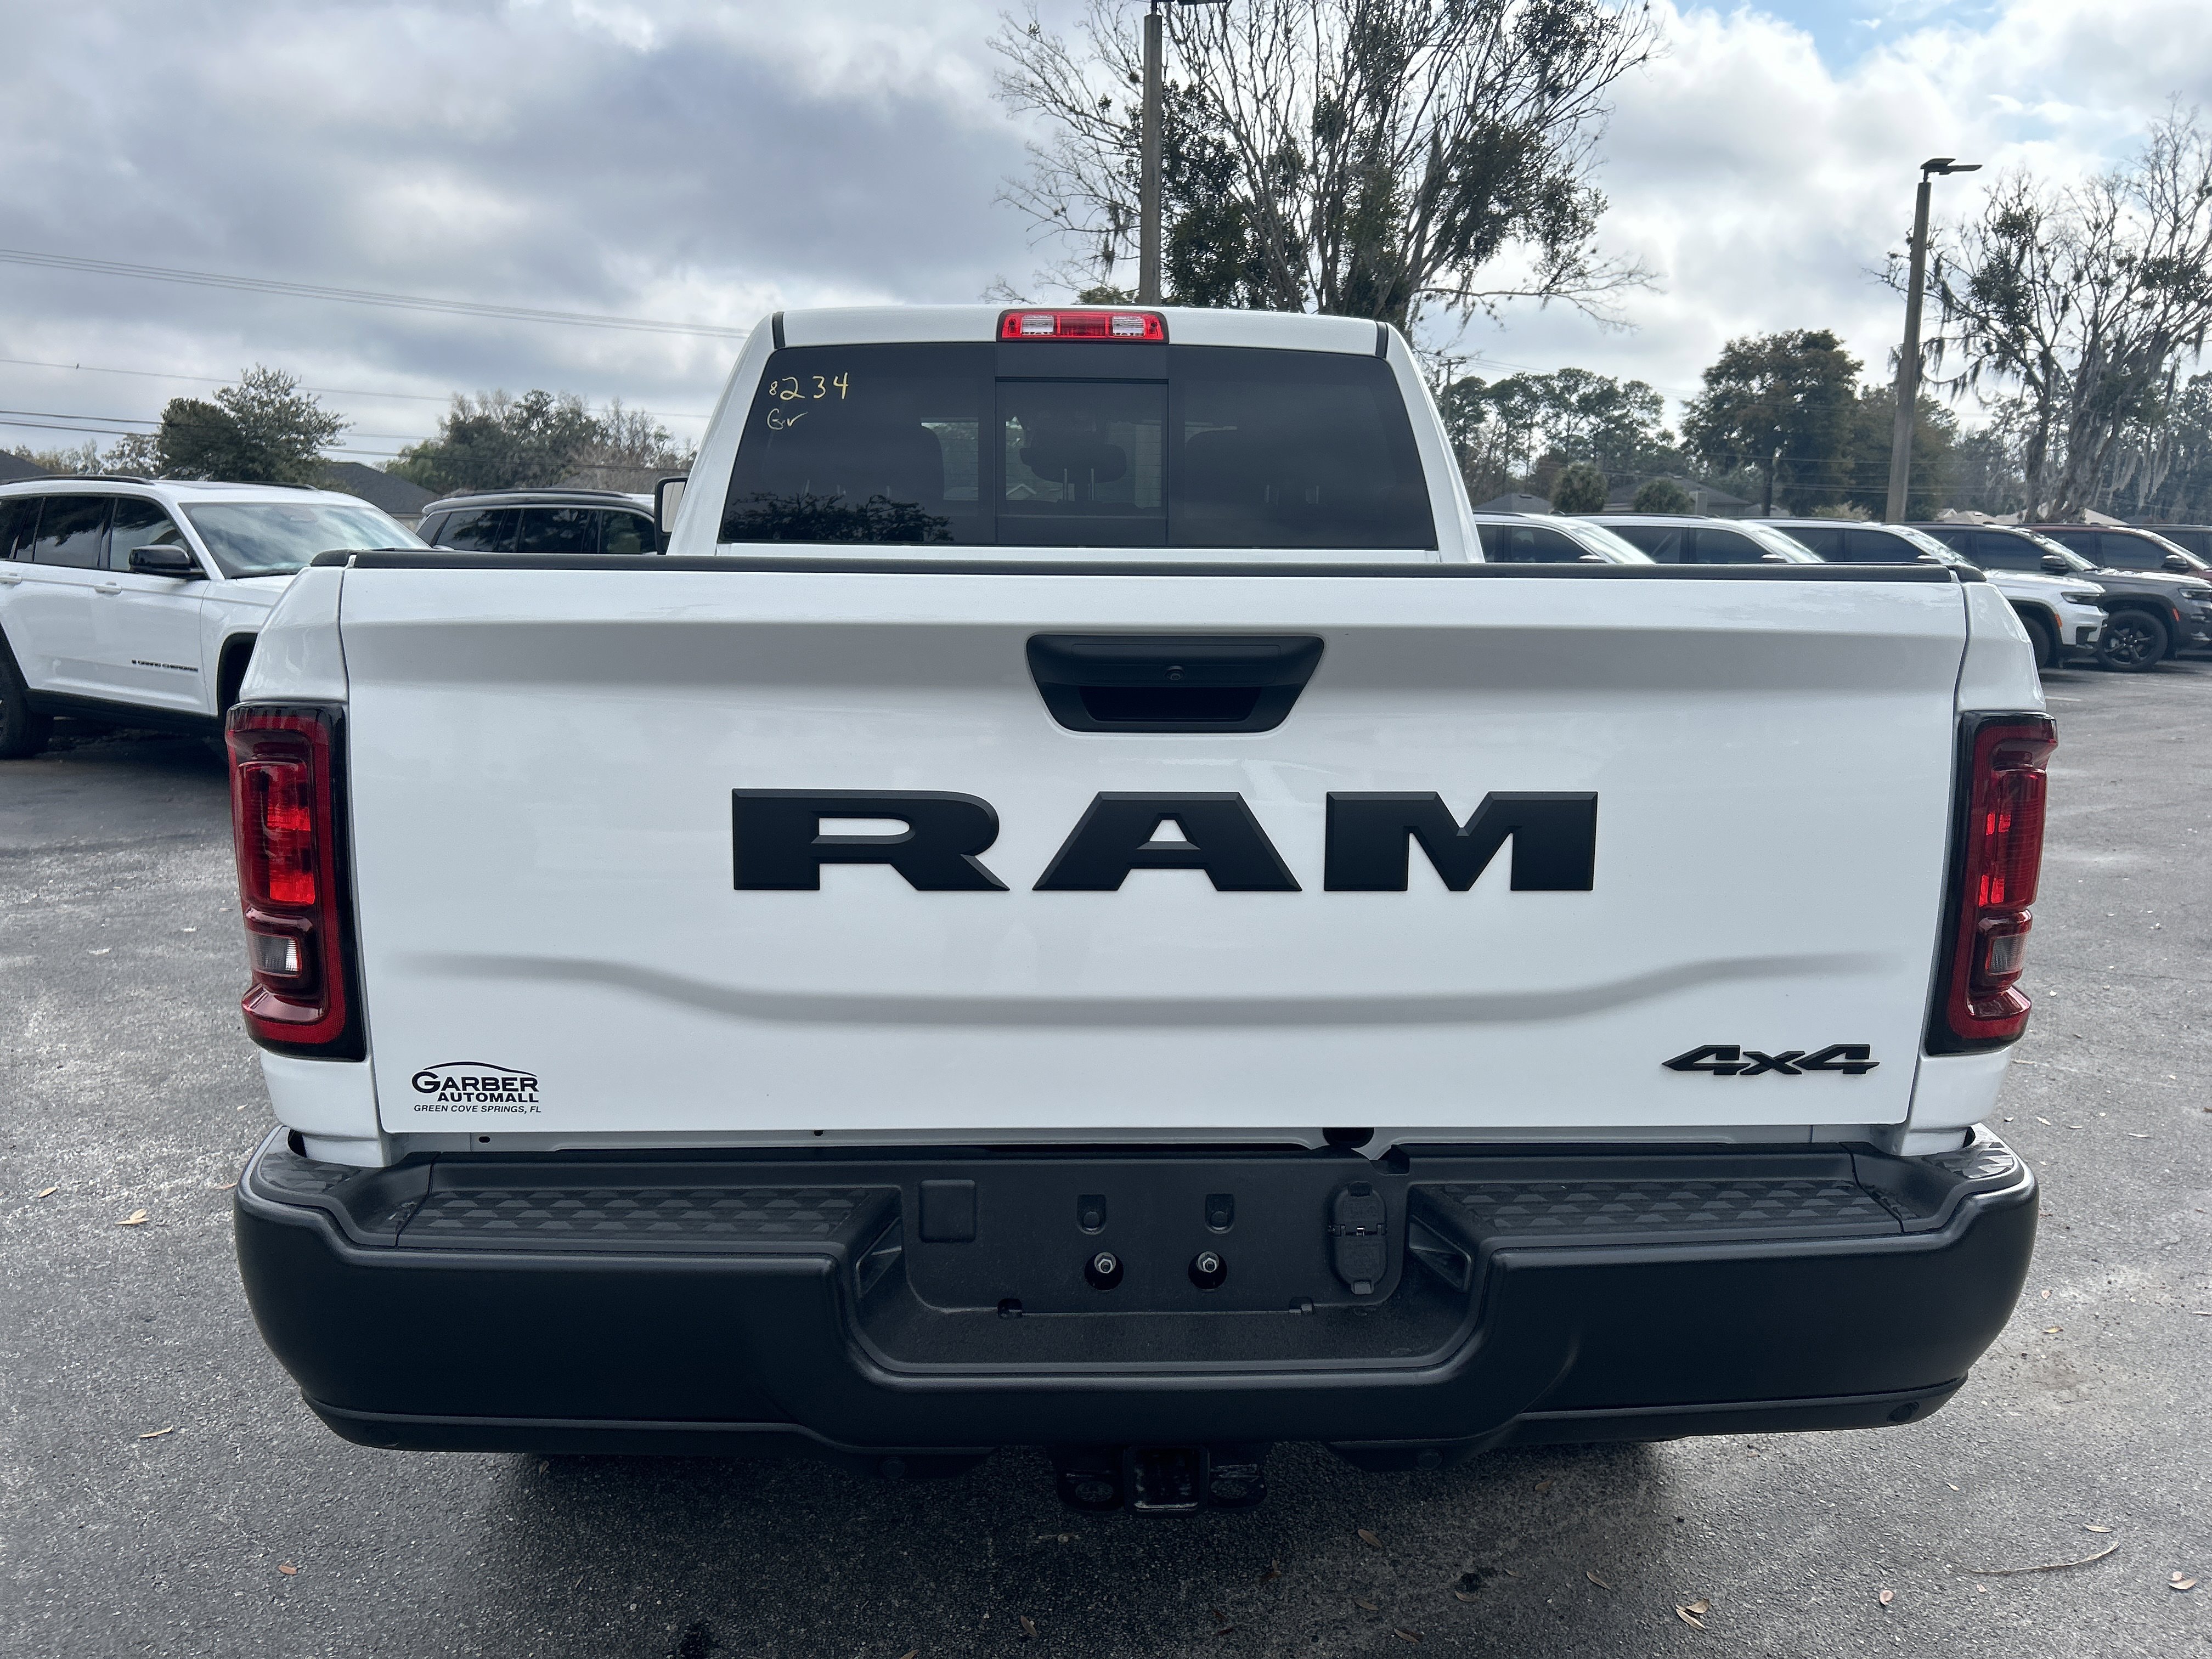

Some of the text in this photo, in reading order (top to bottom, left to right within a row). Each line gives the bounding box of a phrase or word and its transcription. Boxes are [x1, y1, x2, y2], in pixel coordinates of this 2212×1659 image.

[769, 372, 849, 399] 8234
[732, 788, 1599, 891] RAM
[1661, 1043, 1881, 1075] 4x4
[411, 1071, 539, 1093] GARBER
[414, 1104, 448, 1113] GREEN
[481, 1105, 527, 1114] SPRINGS,
[437, 1092, 539, 1103] AUTOMALL
